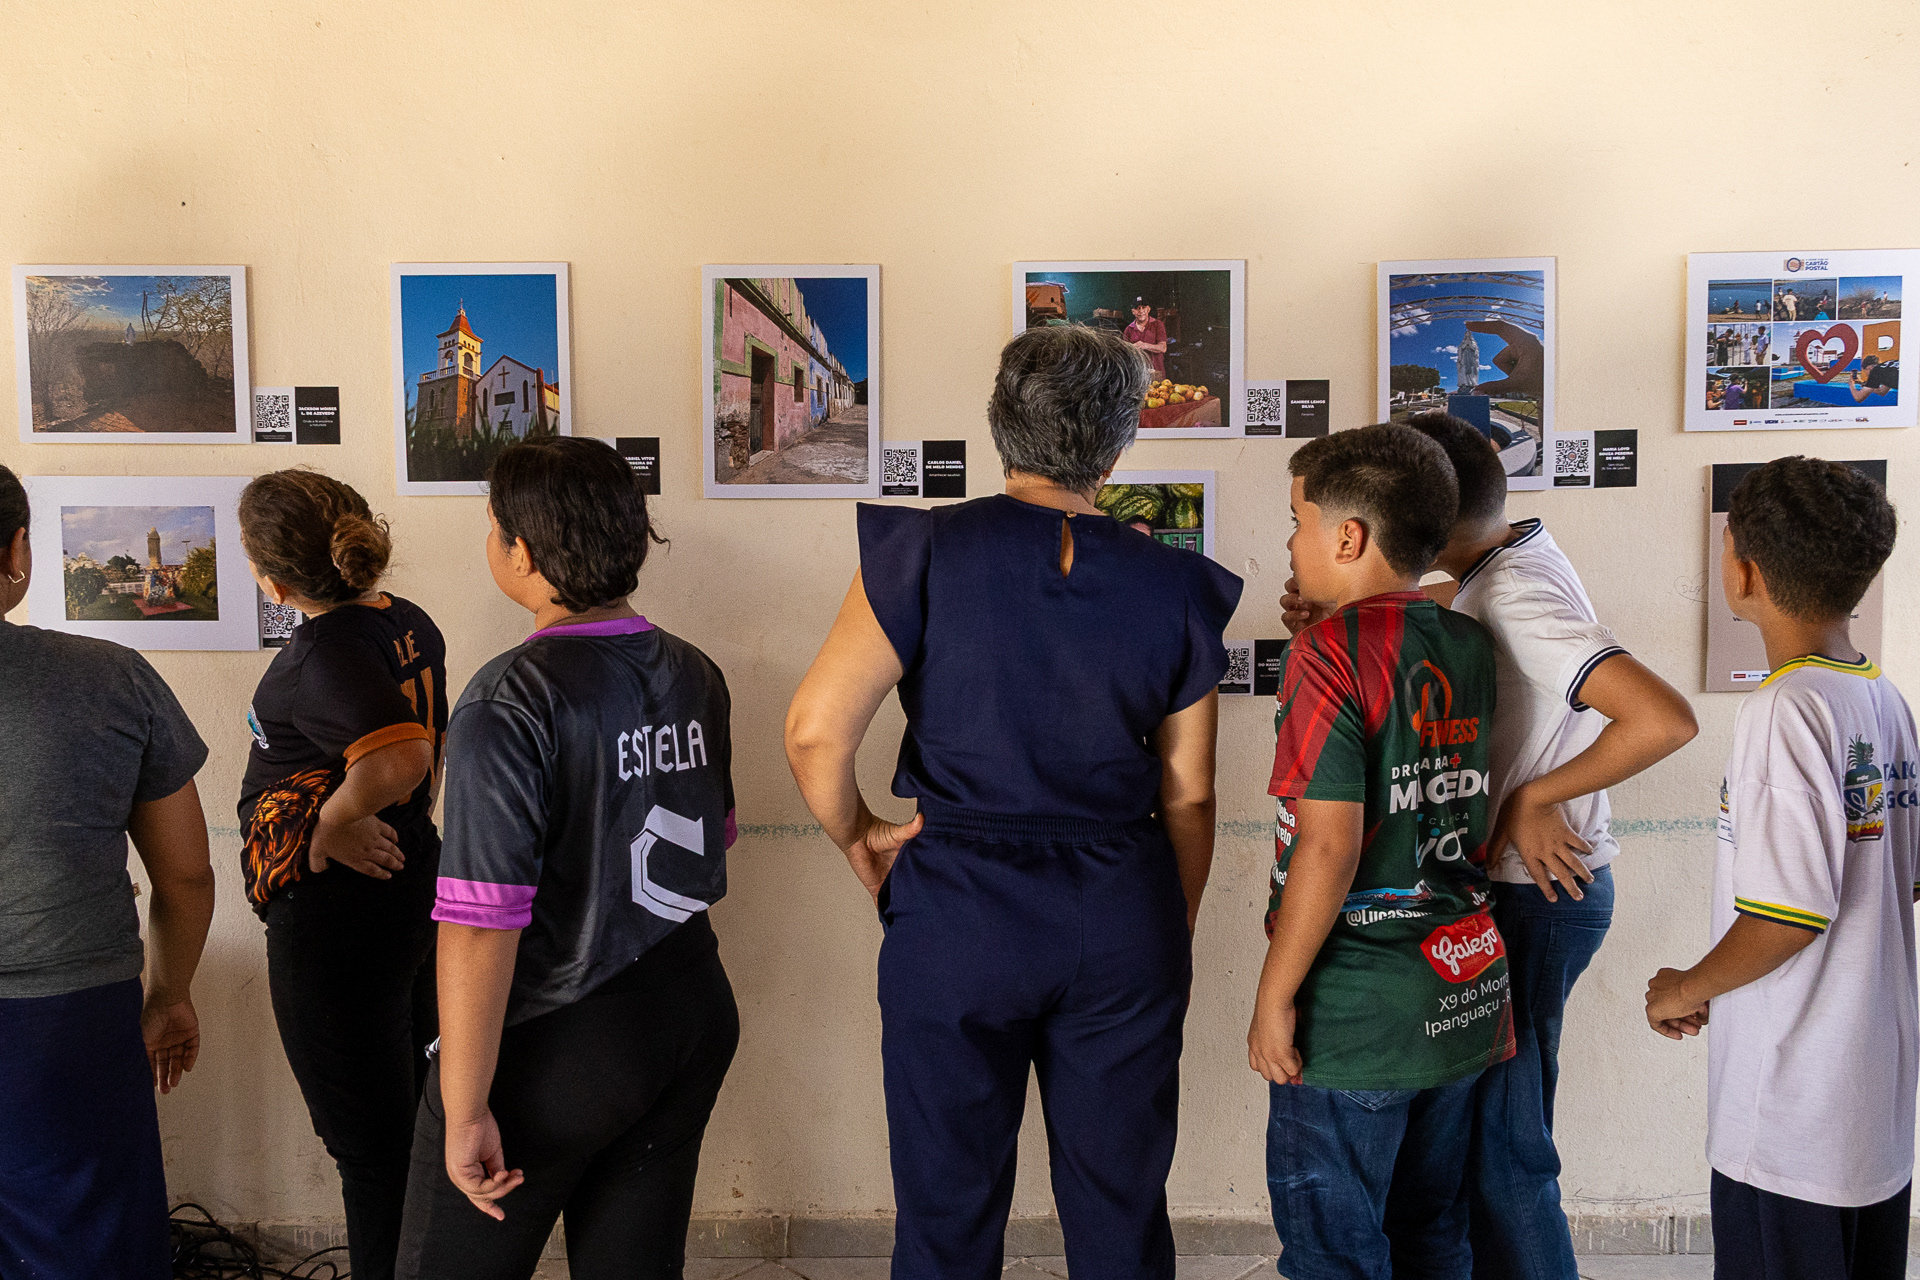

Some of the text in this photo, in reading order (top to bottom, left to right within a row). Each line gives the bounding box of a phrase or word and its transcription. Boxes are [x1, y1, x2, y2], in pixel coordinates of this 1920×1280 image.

[617, 720, 708, 782] ESTELA
[1431, 927, 1498, 975] Galego
[1425, 998, 1499, 1037] Ipanguaçu
[1439, 994, 1458, 1012] X9
[1461, 988, 1478, 1004] do
